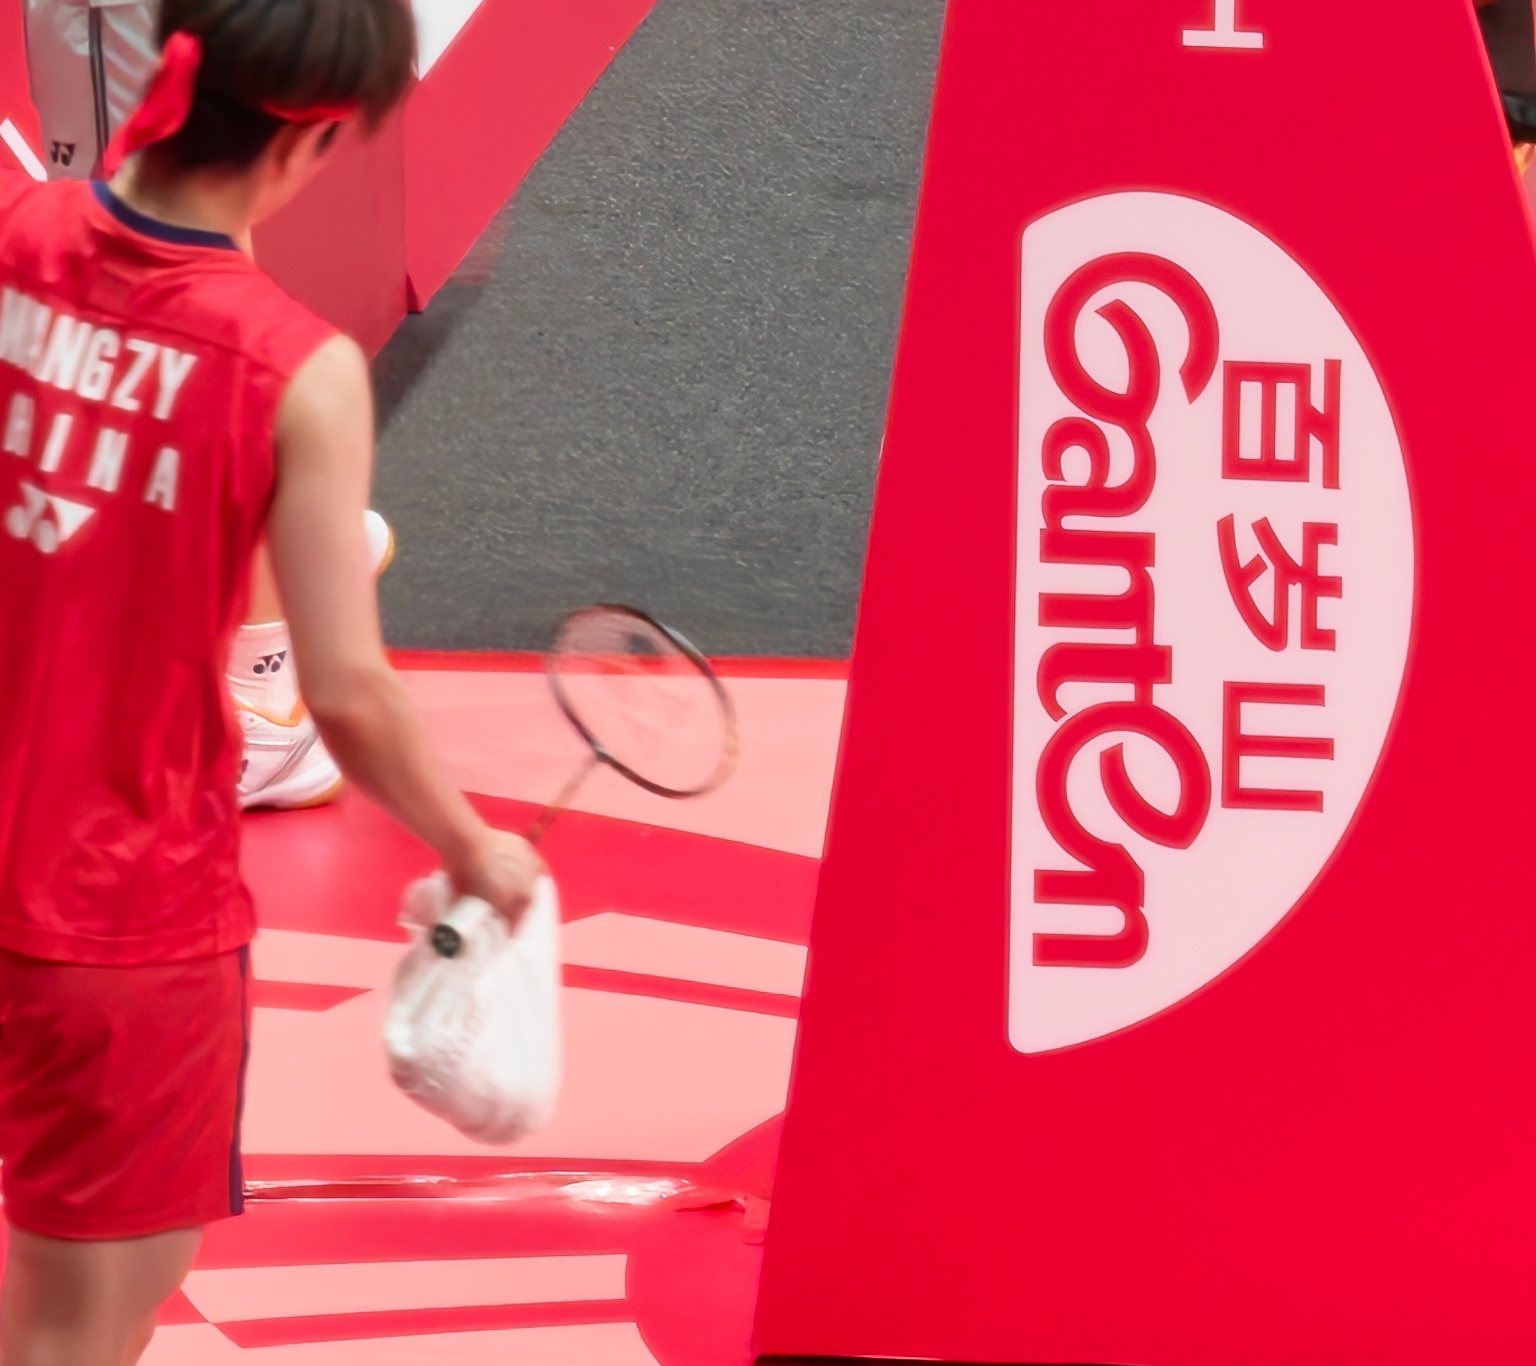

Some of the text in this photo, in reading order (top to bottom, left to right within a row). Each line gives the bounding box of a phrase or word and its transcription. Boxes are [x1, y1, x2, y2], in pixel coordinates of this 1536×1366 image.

[1032, 250, 1220, 969] Ganten
[1220, 358, 1345, 814] 百岁山
